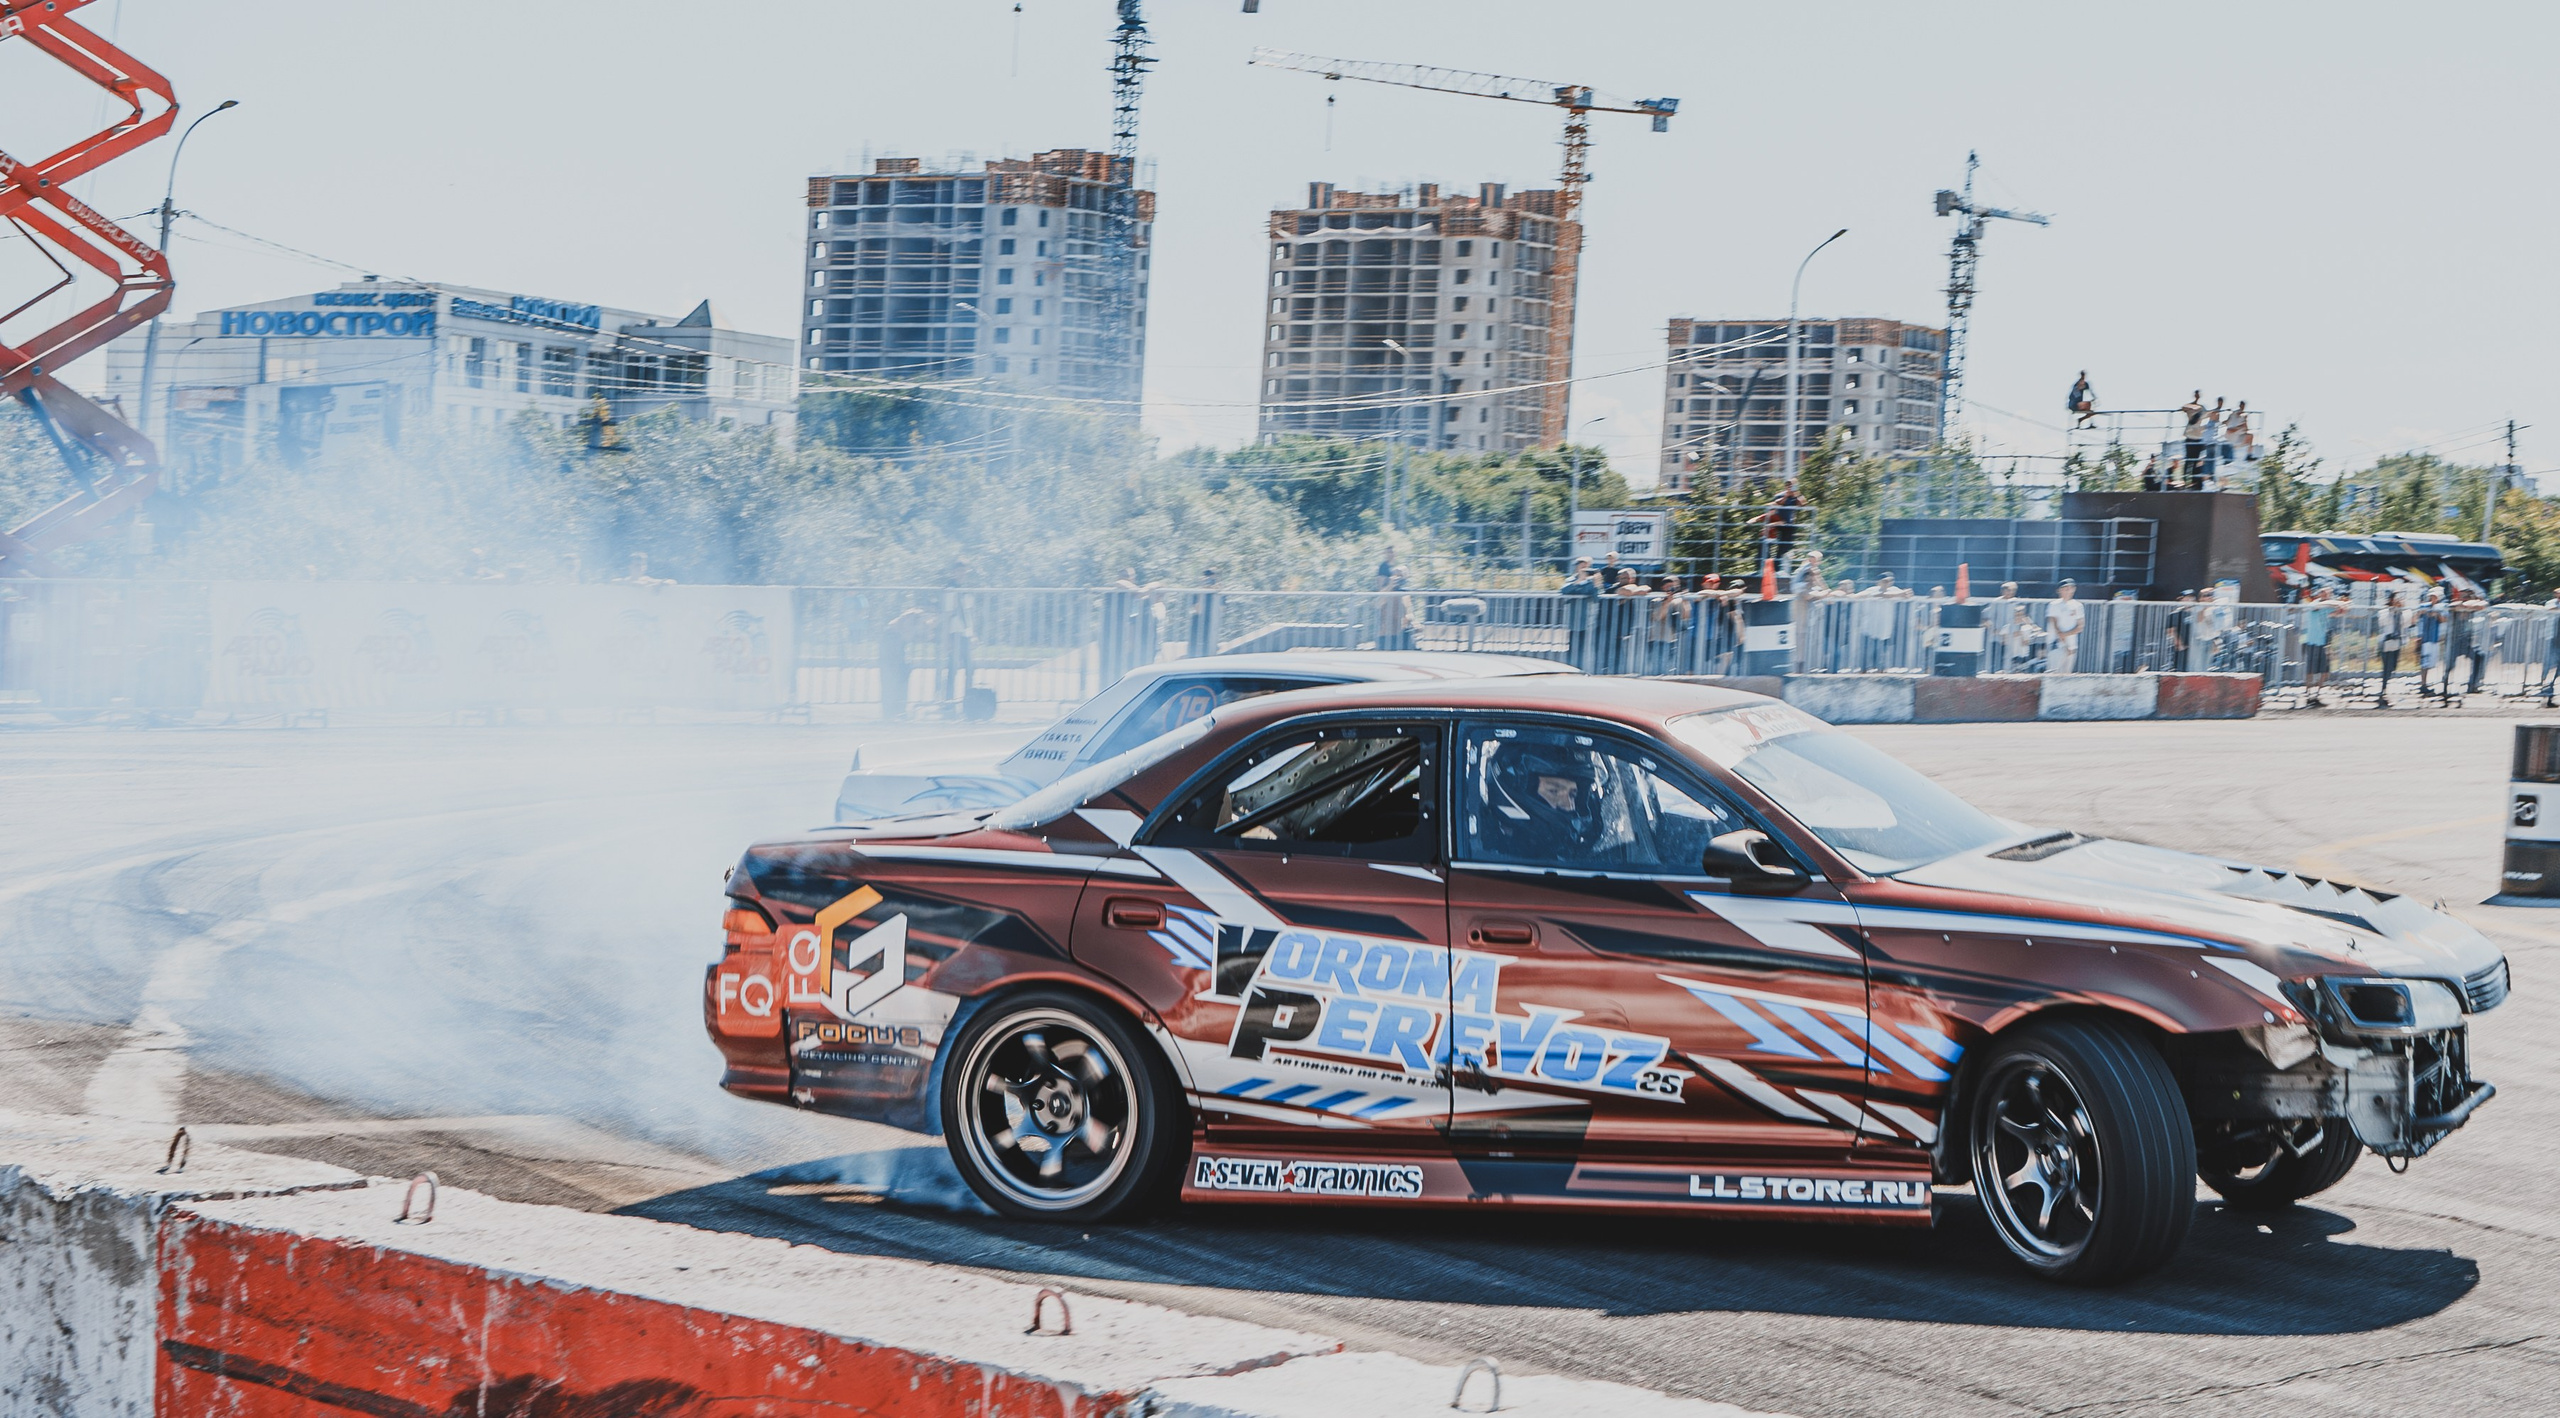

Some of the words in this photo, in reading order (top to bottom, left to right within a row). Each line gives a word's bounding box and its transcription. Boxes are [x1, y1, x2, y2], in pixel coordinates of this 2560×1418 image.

[220, 309, 437, 337] НОВОСТРОЙ
[1024, 749, 1069, 761] BRIDE
[788, 930, 821, 1003] FQ
[1214, 925, 1496, 1013] VORONA
[719, 972, 774, 1017] FQ
[798, 1020, 922, 1047] FOCUS
[1230, 986, 1668, 1091] PEREVOZ
[1689, 1174, 1925, 1205] LLSTORE.RU
